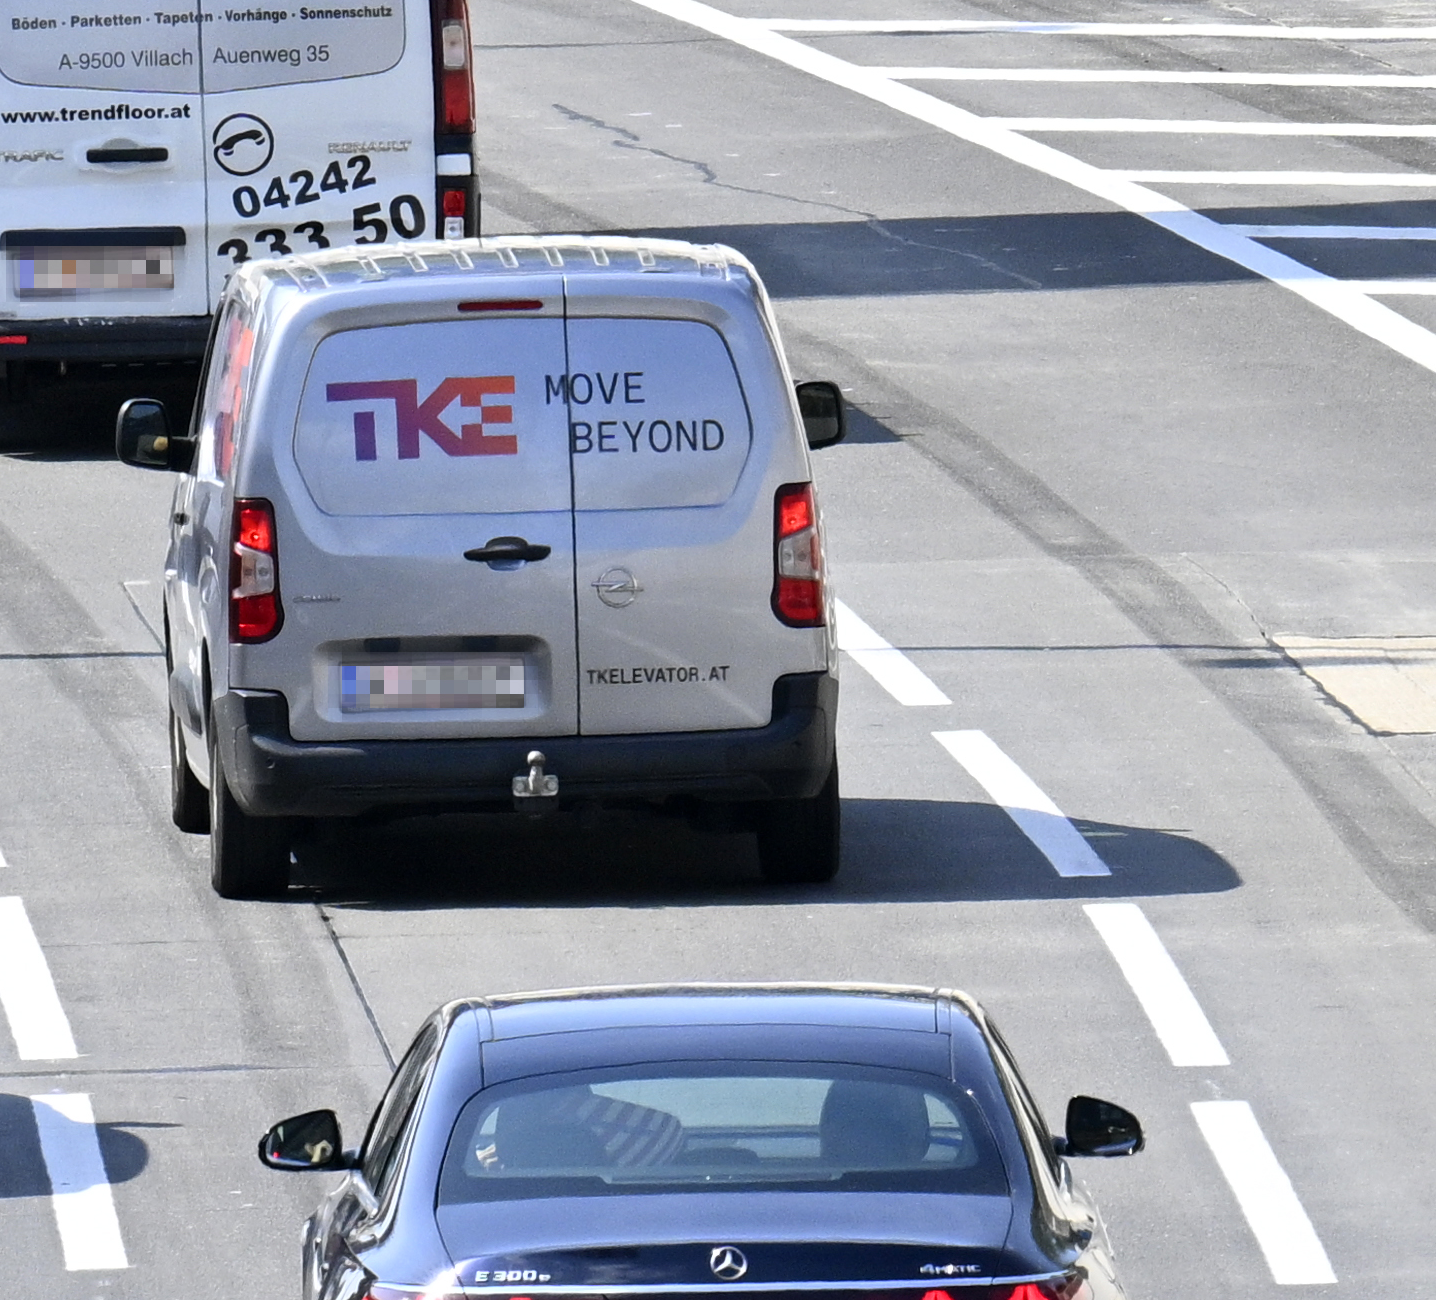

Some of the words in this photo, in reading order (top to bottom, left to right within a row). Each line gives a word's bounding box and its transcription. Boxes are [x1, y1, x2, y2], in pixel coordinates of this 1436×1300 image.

[11, 15, 58, 31] Böden
[70, 12, 143, 28] Parketten
[154, 10, 214, 27] Tapeten
[225, 7, 288, 25] Vorhänge
[300, 5, 393, 21] Sonnenschutz
[58, 51, 126, 70] A-9500
[131, 48, 194, 68] Villach
[213, 46, 301, 68] Auenweg
[306, 44, 331, 63] 35
[1, 103, 192, 125] www.trendfloor.at
[328, 139, 412, 155] RENAULT
[232, 154, 377, 219] 04242
[352, 193, 427, 245] 50
[544, 371, 646, 406] MOVE
[326, 375, 518, 461] TKE
[571, 419, 725, 455] BEYOND
[586, 665, 731, 685] TKELEVATOR.AT
